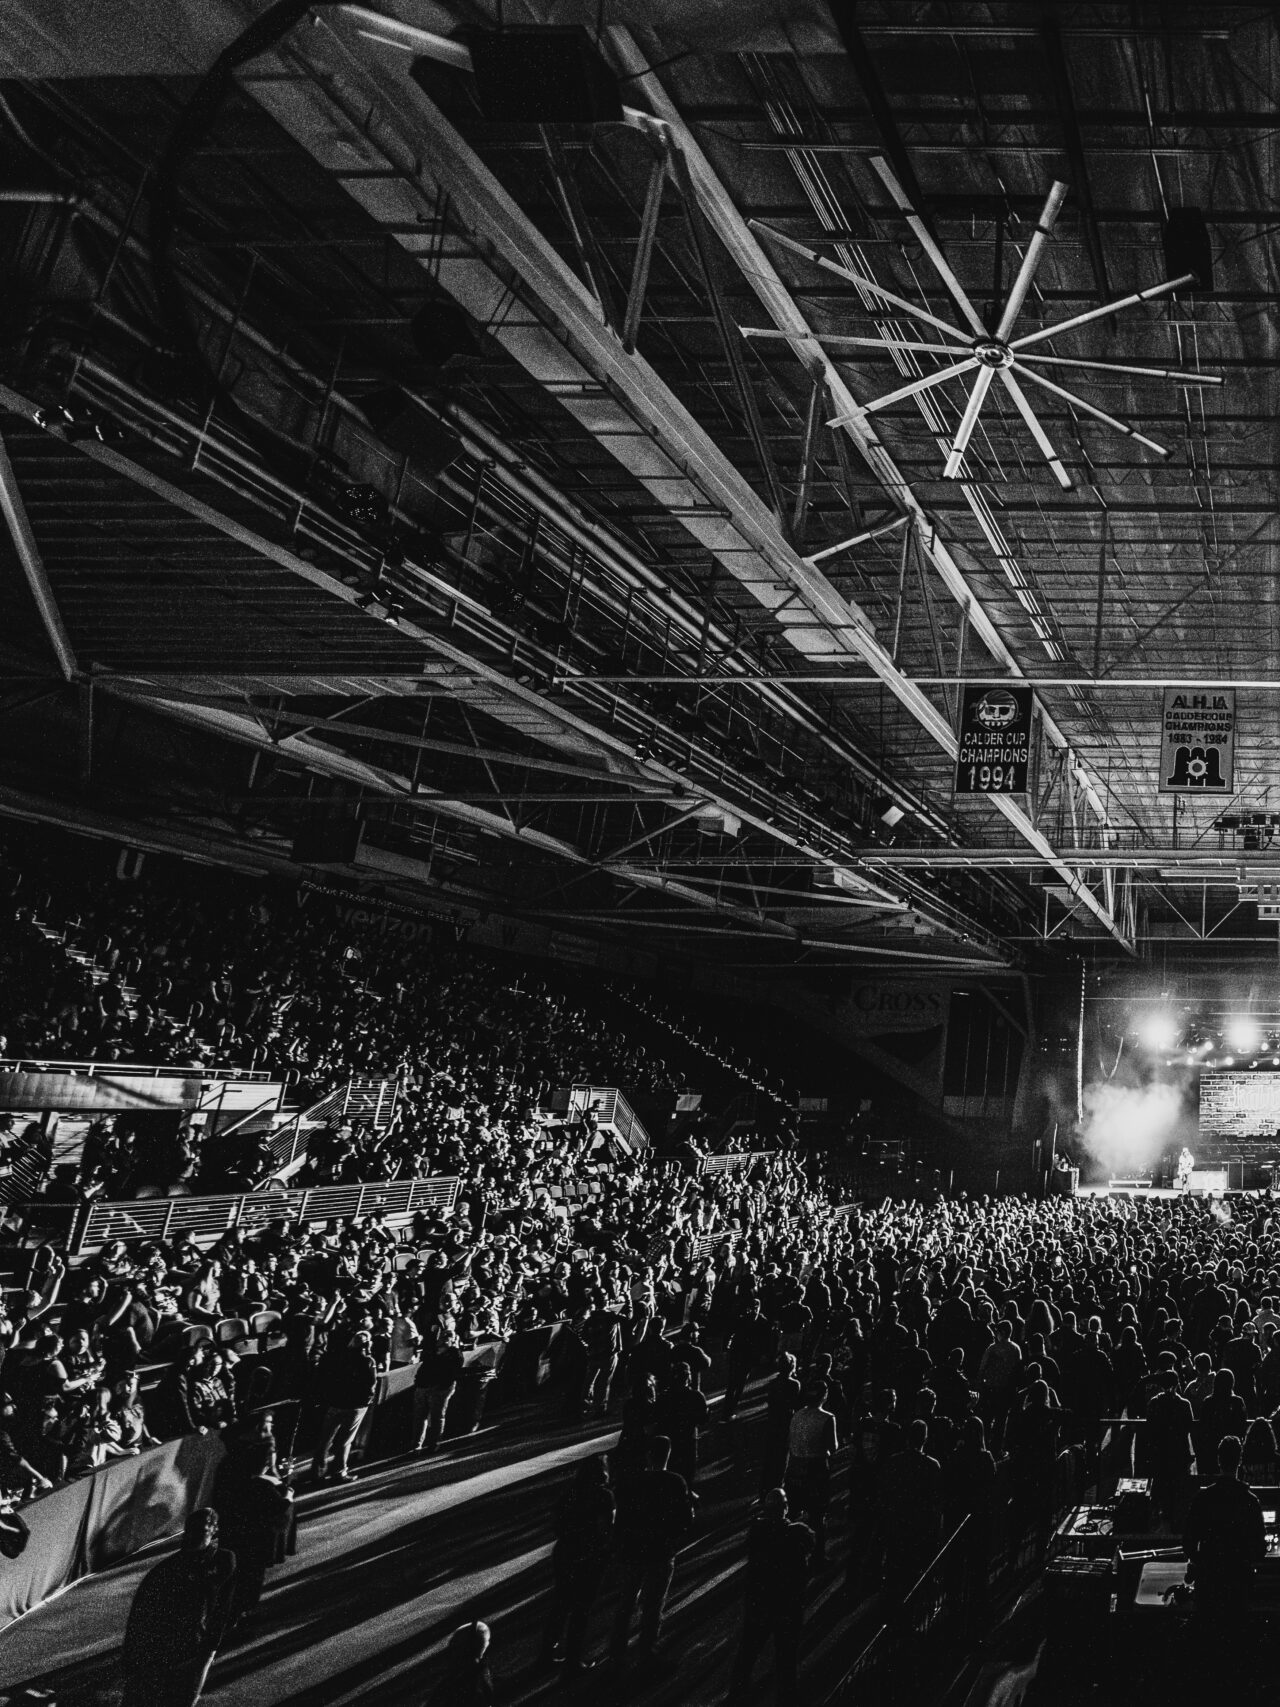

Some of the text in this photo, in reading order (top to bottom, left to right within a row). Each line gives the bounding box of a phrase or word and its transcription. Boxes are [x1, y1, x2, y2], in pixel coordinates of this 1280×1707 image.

[1165, 721, 1232, 732] CHAMPIONS
[964, 732, 1026, 745] CALDER CUP
[960, 748, 1028, 763] CHAMPIONS
[968, 766, 1016, 790] 1994
[116, 849, 145, 880] U
